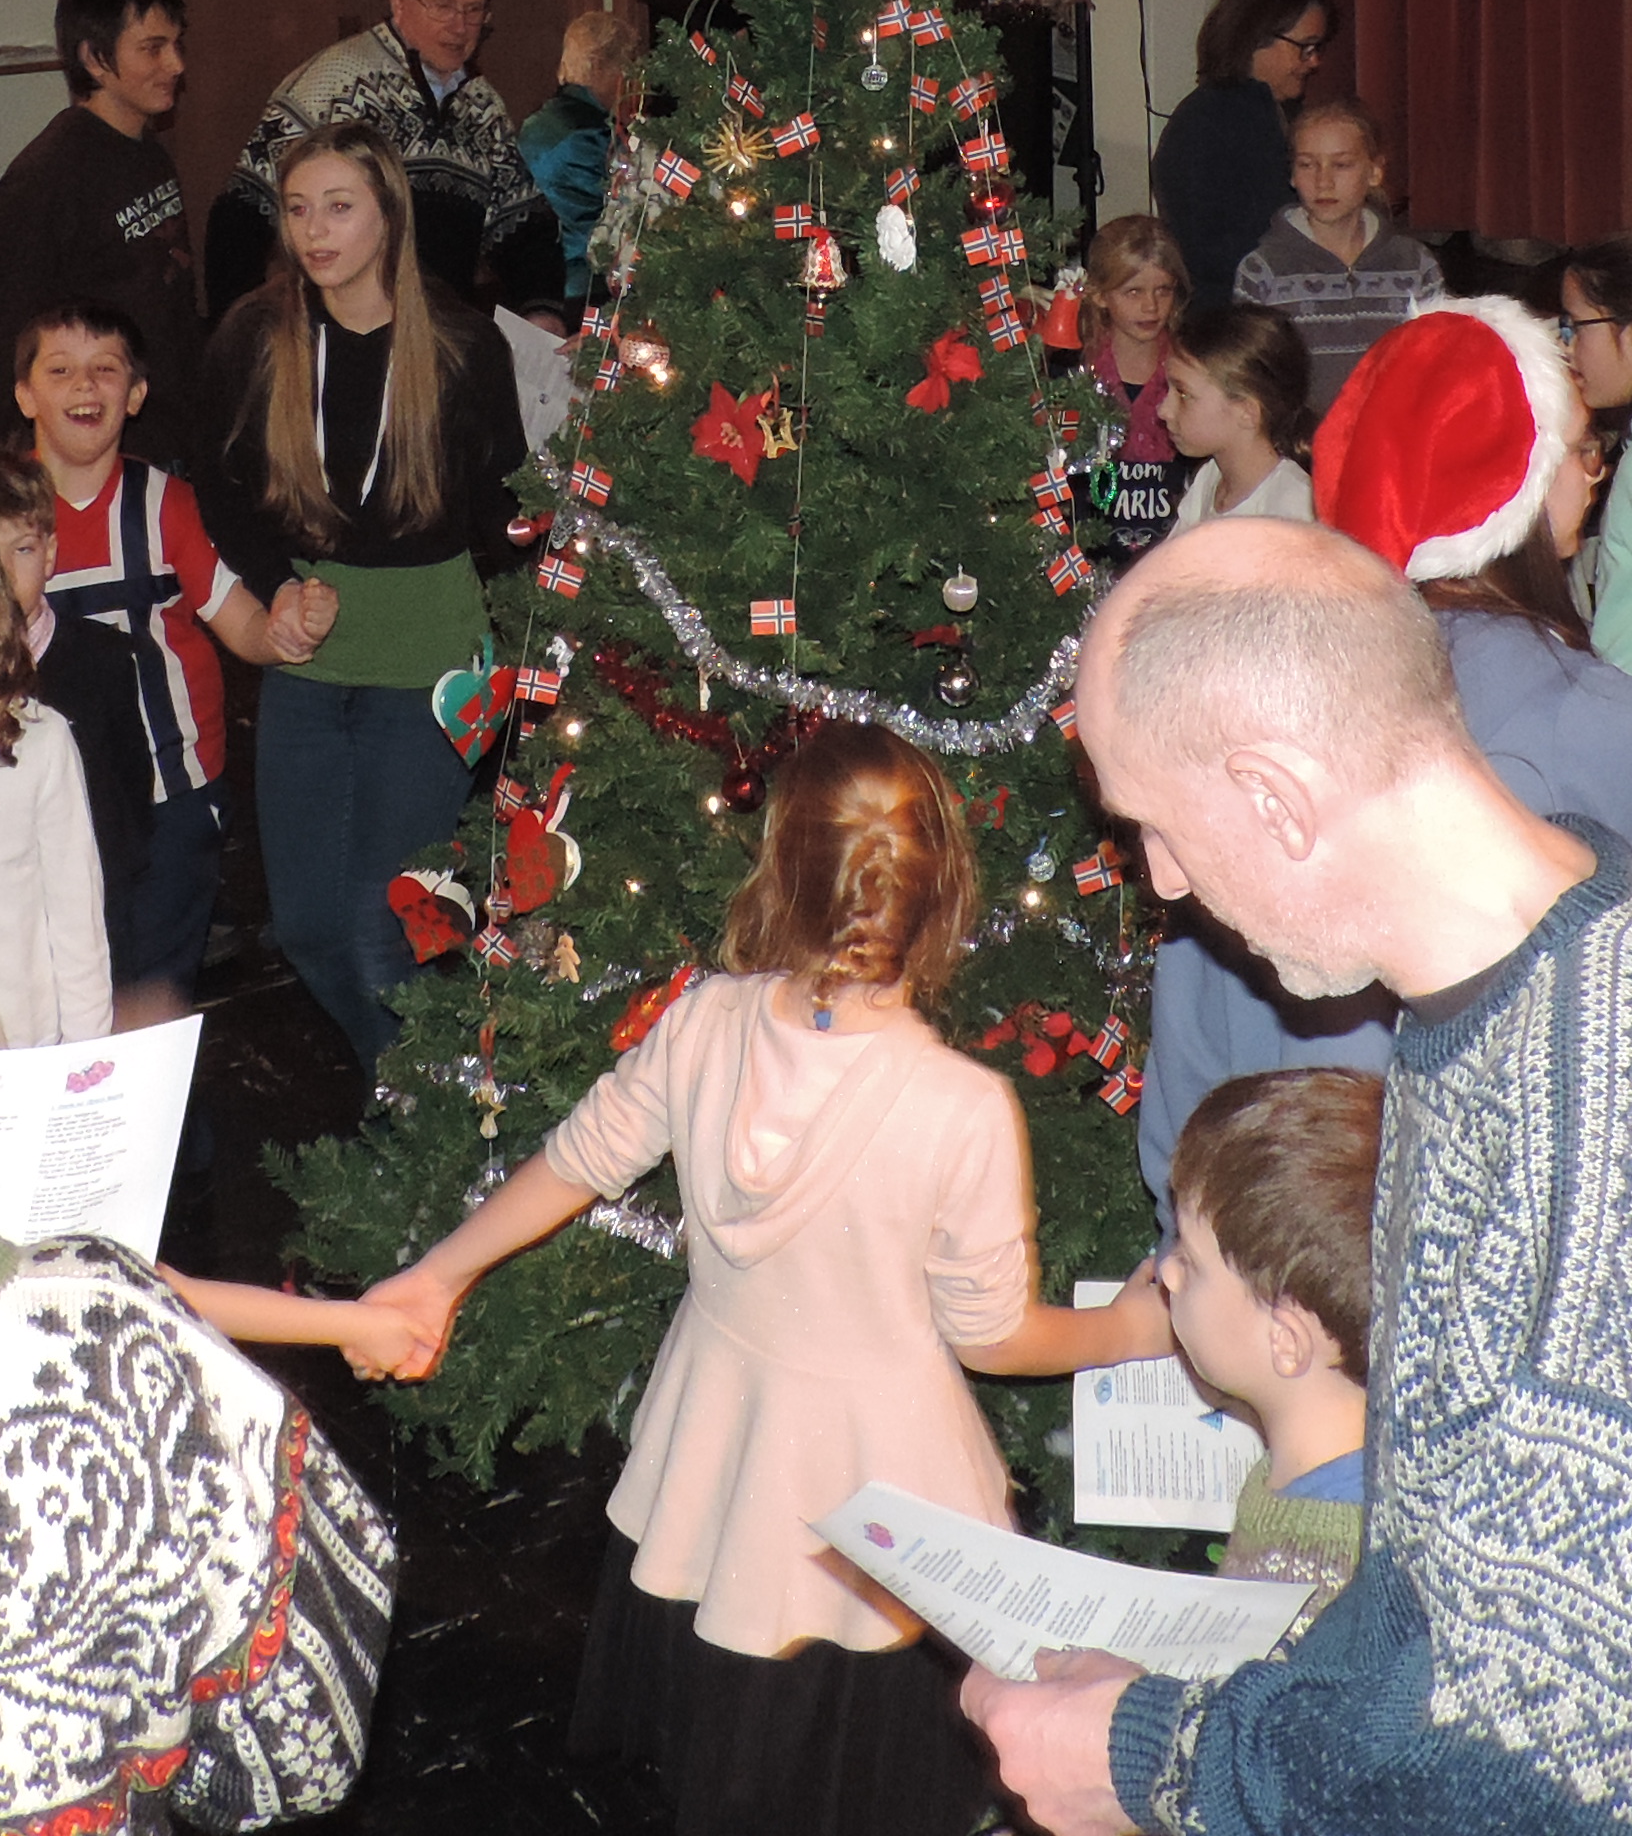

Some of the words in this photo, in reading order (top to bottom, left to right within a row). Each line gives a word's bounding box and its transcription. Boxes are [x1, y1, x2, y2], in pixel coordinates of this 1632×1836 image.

[115, 196, 149, 228] HAVE
[1118, 461, 1167, 483] rom
[1113, 487, 1171, 521] ARIS
